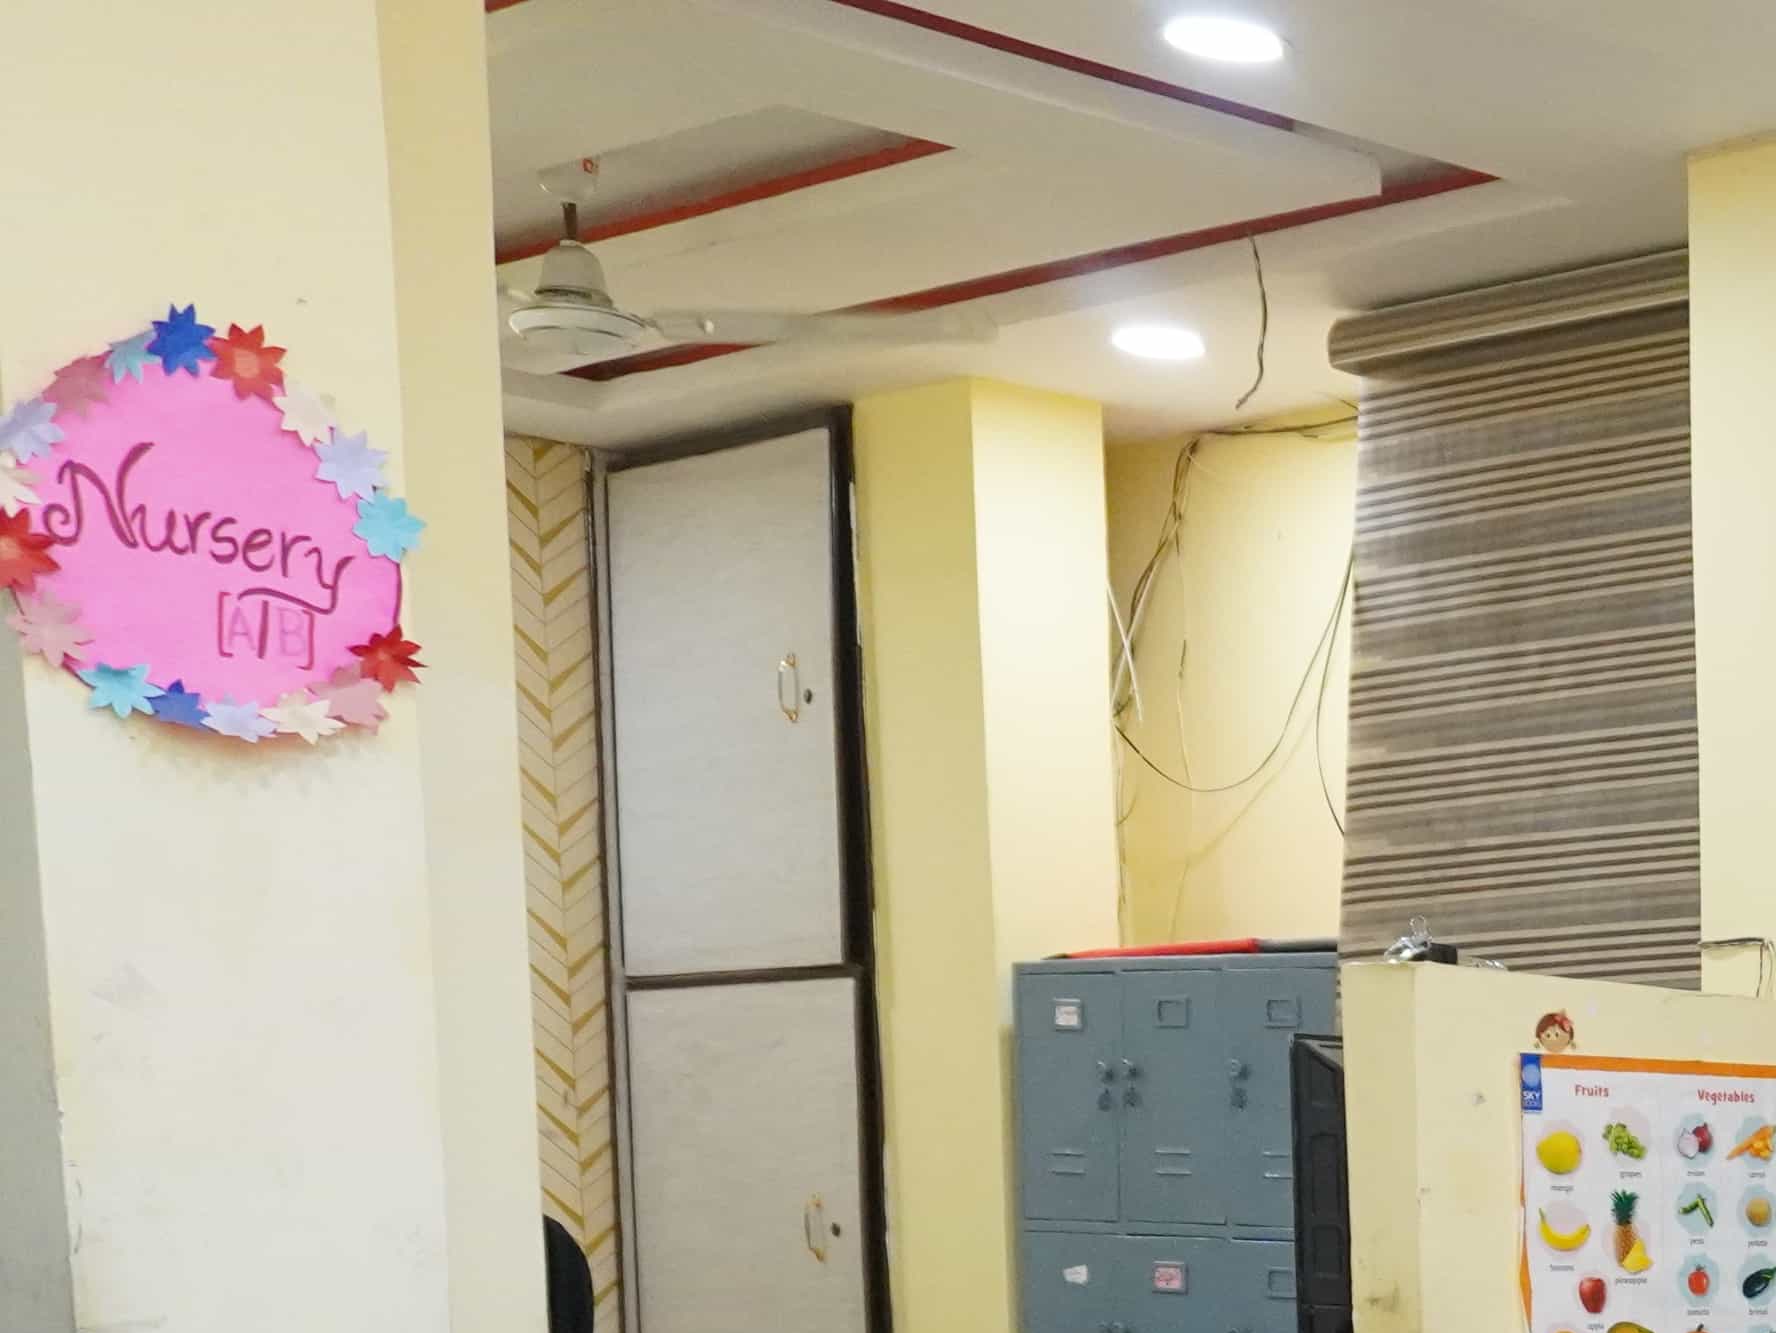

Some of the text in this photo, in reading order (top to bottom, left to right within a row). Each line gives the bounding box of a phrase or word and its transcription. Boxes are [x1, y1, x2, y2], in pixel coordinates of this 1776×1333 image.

[43, 442, 357, 614] Nursery
[1522, 1090, 1541, 1100] SKY
[1575, 1084, 1610, 1097] Fruits
[1697, 1089, 1755, 1105] Vegetables
